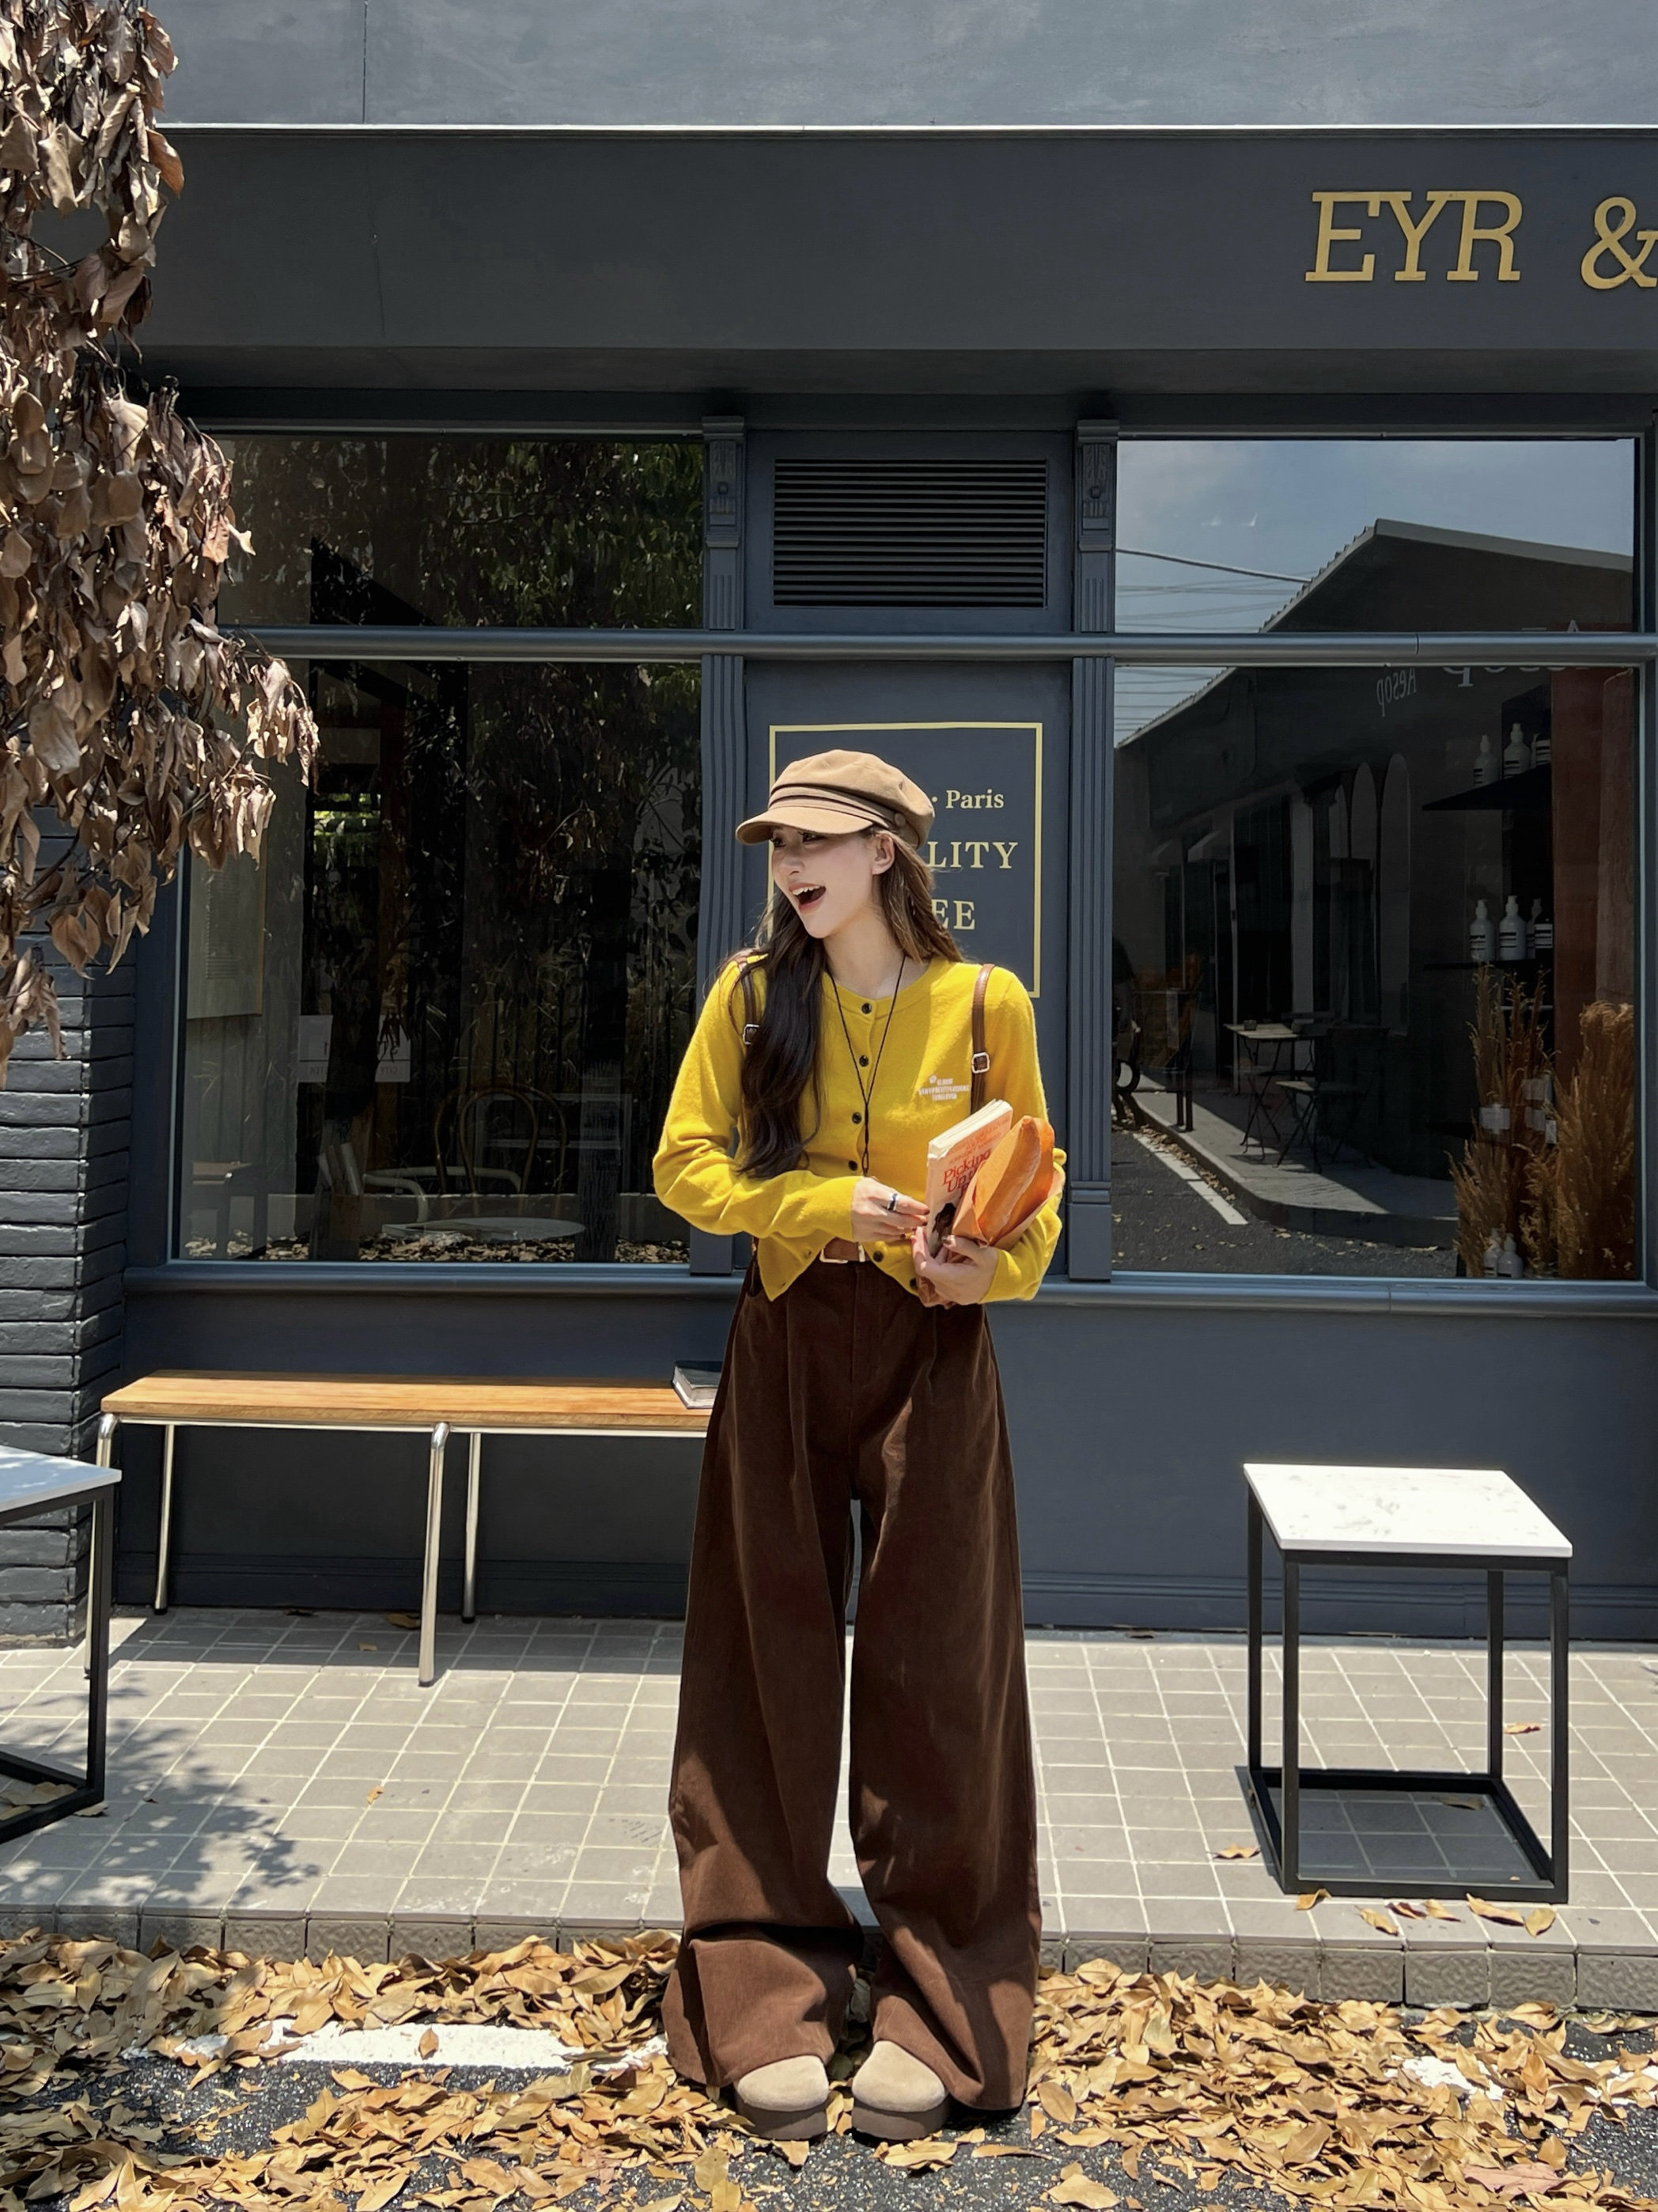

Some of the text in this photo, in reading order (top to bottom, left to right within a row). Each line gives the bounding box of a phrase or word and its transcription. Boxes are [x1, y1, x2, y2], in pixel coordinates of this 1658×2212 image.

[1305, 190, 1658, 290] EYR &
[945, 789, 1005, 809] Paris
[927, 841, 1019, 869] LITY
[932, 899, 975, 930] EE
